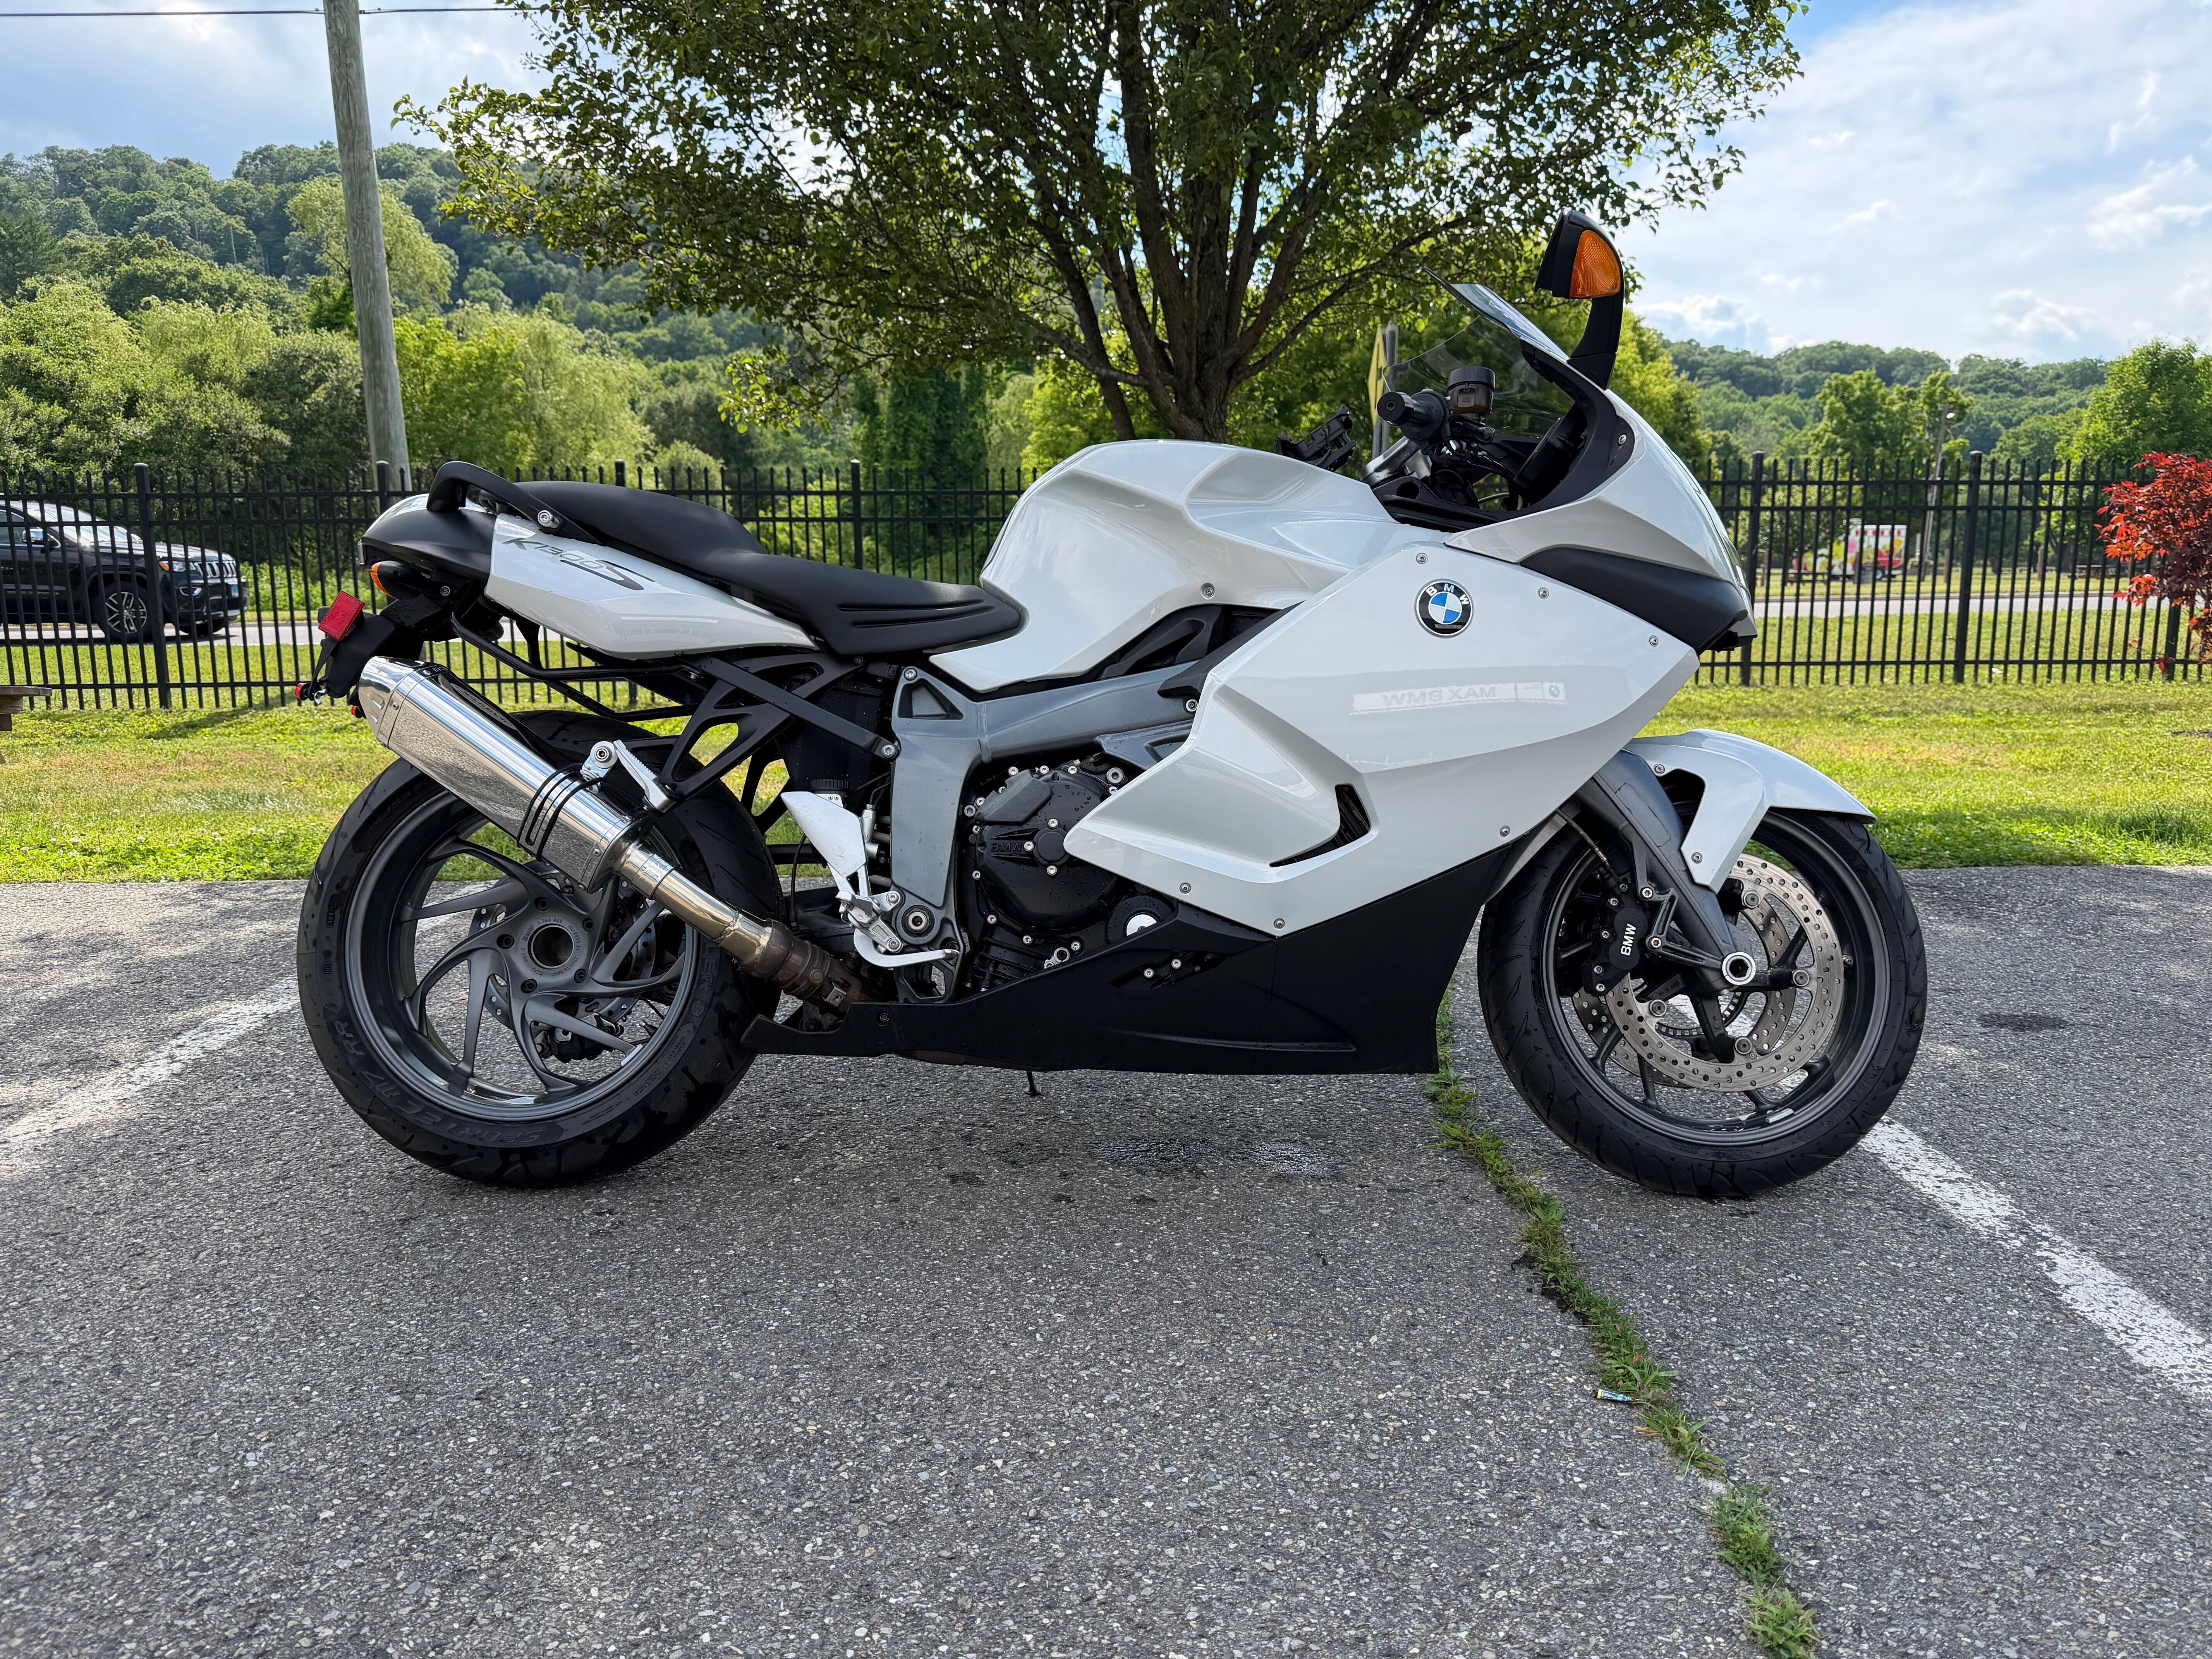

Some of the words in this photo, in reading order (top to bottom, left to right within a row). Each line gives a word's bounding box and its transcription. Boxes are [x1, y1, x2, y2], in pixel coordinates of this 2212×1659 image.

[1426, 583, 1469, 606] BMW
[991, 842, 1022, 852] BMW
[1620, 924, 1637, 956] BMW
[334, 1020, 364, 1056] RR
[361, 1071, 400, 1099] M7
[1820, 1073, 1877, 1128] METZELER
[396, 1100, 547, 1144] SPORTEC
